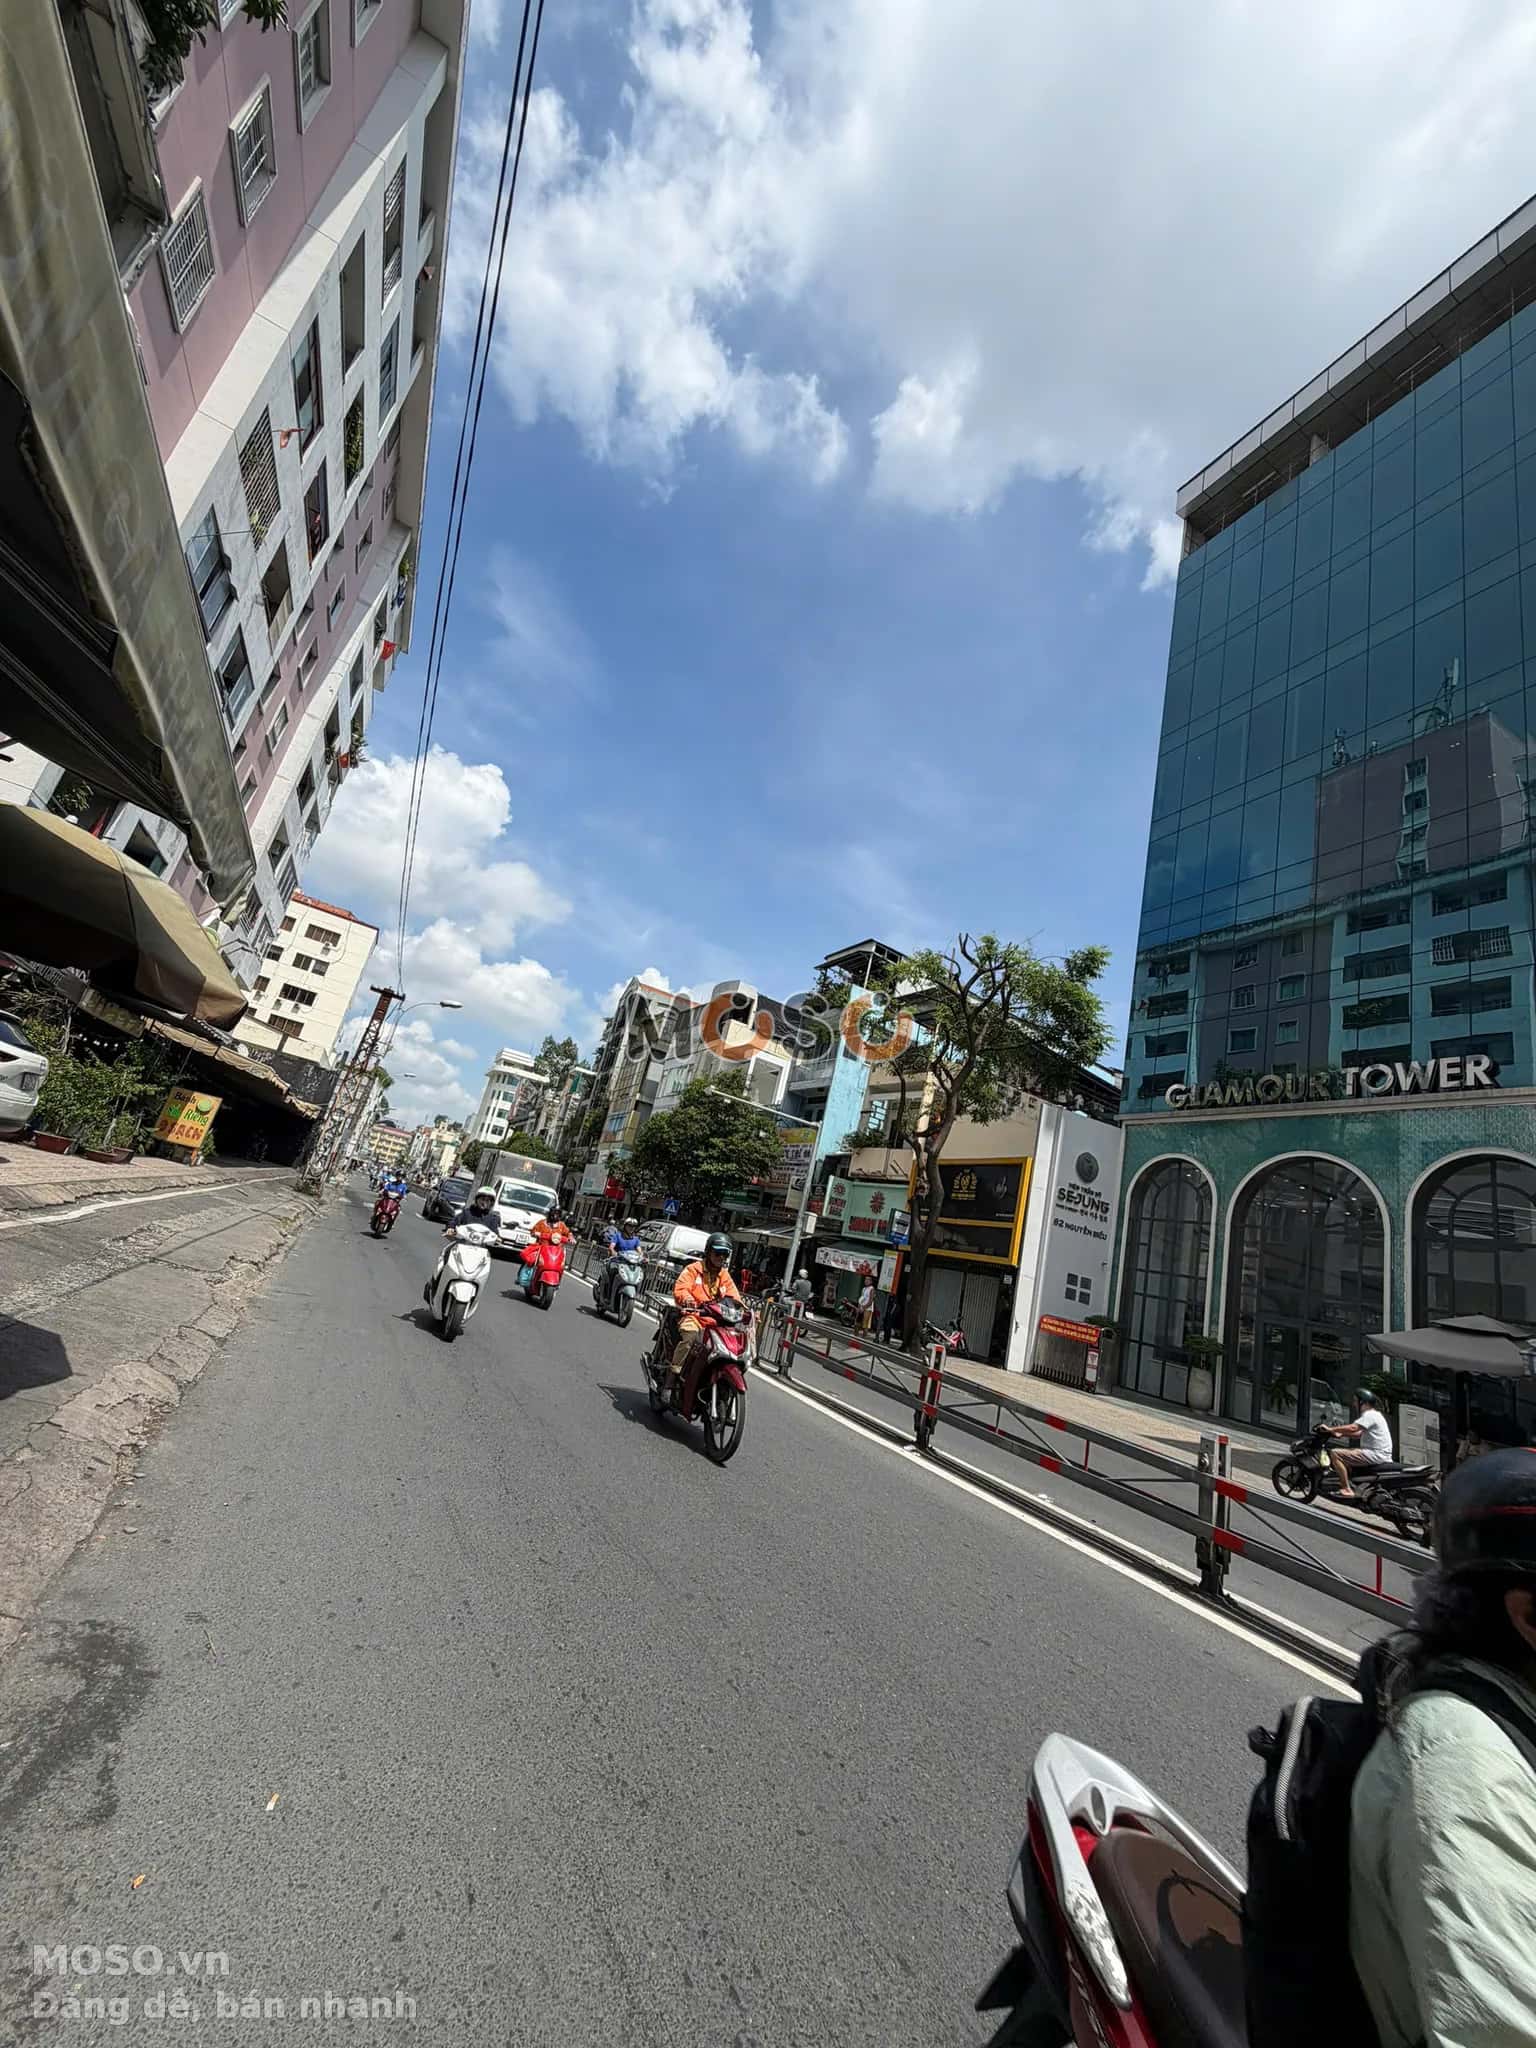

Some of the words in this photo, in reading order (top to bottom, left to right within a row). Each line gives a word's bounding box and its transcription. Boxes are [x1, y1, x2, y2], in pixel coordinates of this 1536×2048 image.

[1165, 1074, 1331, 1108] GLAMOUR
[1341, 1054, 1494, 1096] TOWER
[1057, 1187, 1110, 1214] SEJUNG
